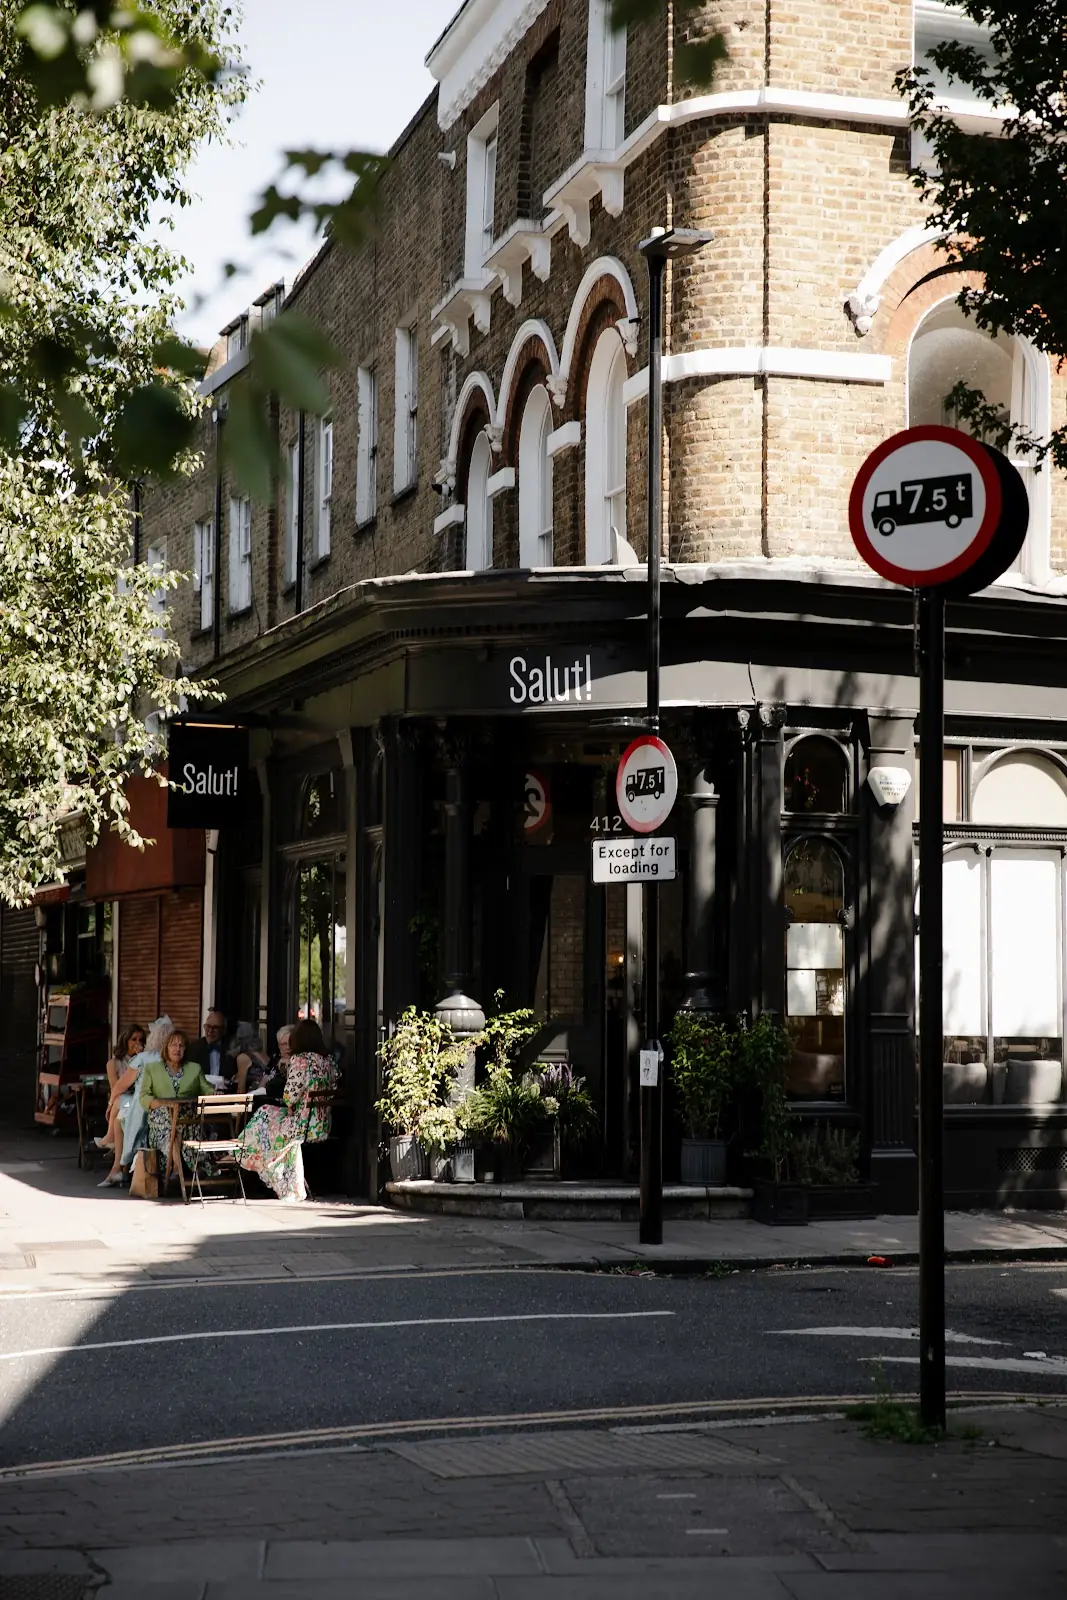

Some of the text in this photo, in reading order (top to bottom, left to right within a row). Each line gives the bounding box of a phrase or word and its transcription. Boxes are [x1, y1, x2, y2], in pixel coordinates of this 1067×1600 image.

[904, 481, 965, 514] 7.5 t
[509, 654, 592, 704] Salut!
[183, 763, 238, 796] Salut!
[637, 769, 664, 790] 7.5 T
[589, 815, 623, 832] 412
[598, 844, 670, 860] Except for
[609, 861, 659, 875] loading
